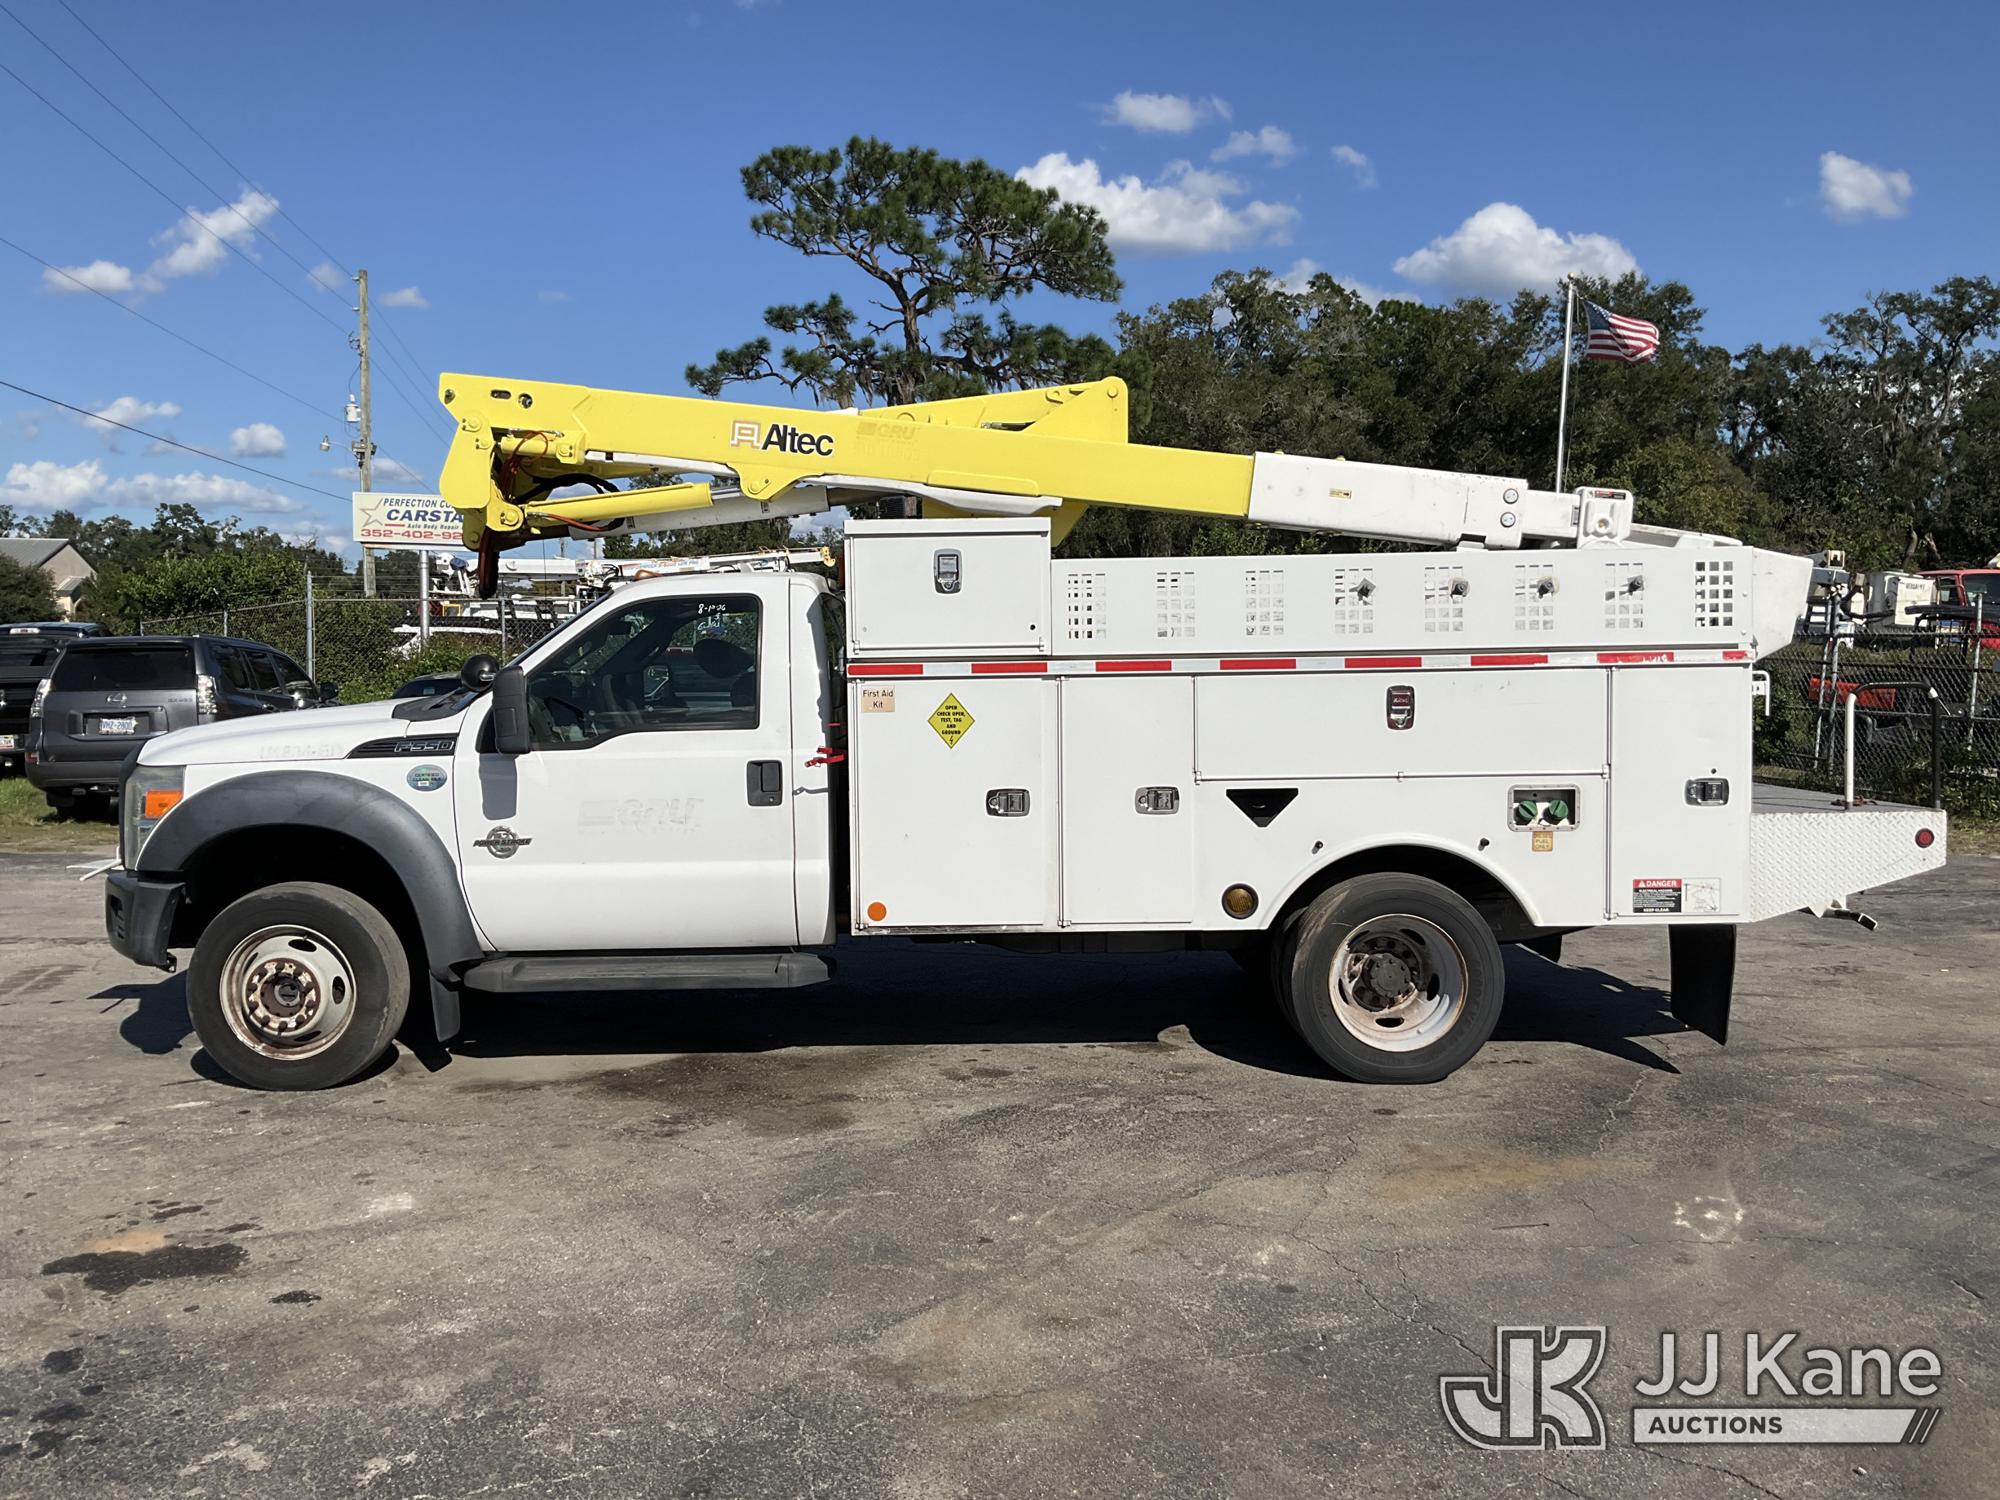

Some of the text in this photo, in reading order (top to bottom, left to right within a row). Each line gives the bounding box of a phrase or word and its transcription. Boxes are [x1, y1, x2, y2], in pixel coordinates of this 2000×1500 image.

[761, 423, 834, 456] Altec
[383, 498, 438, 508] PERFECTION
[863, 689, 894, 697] First Aid
